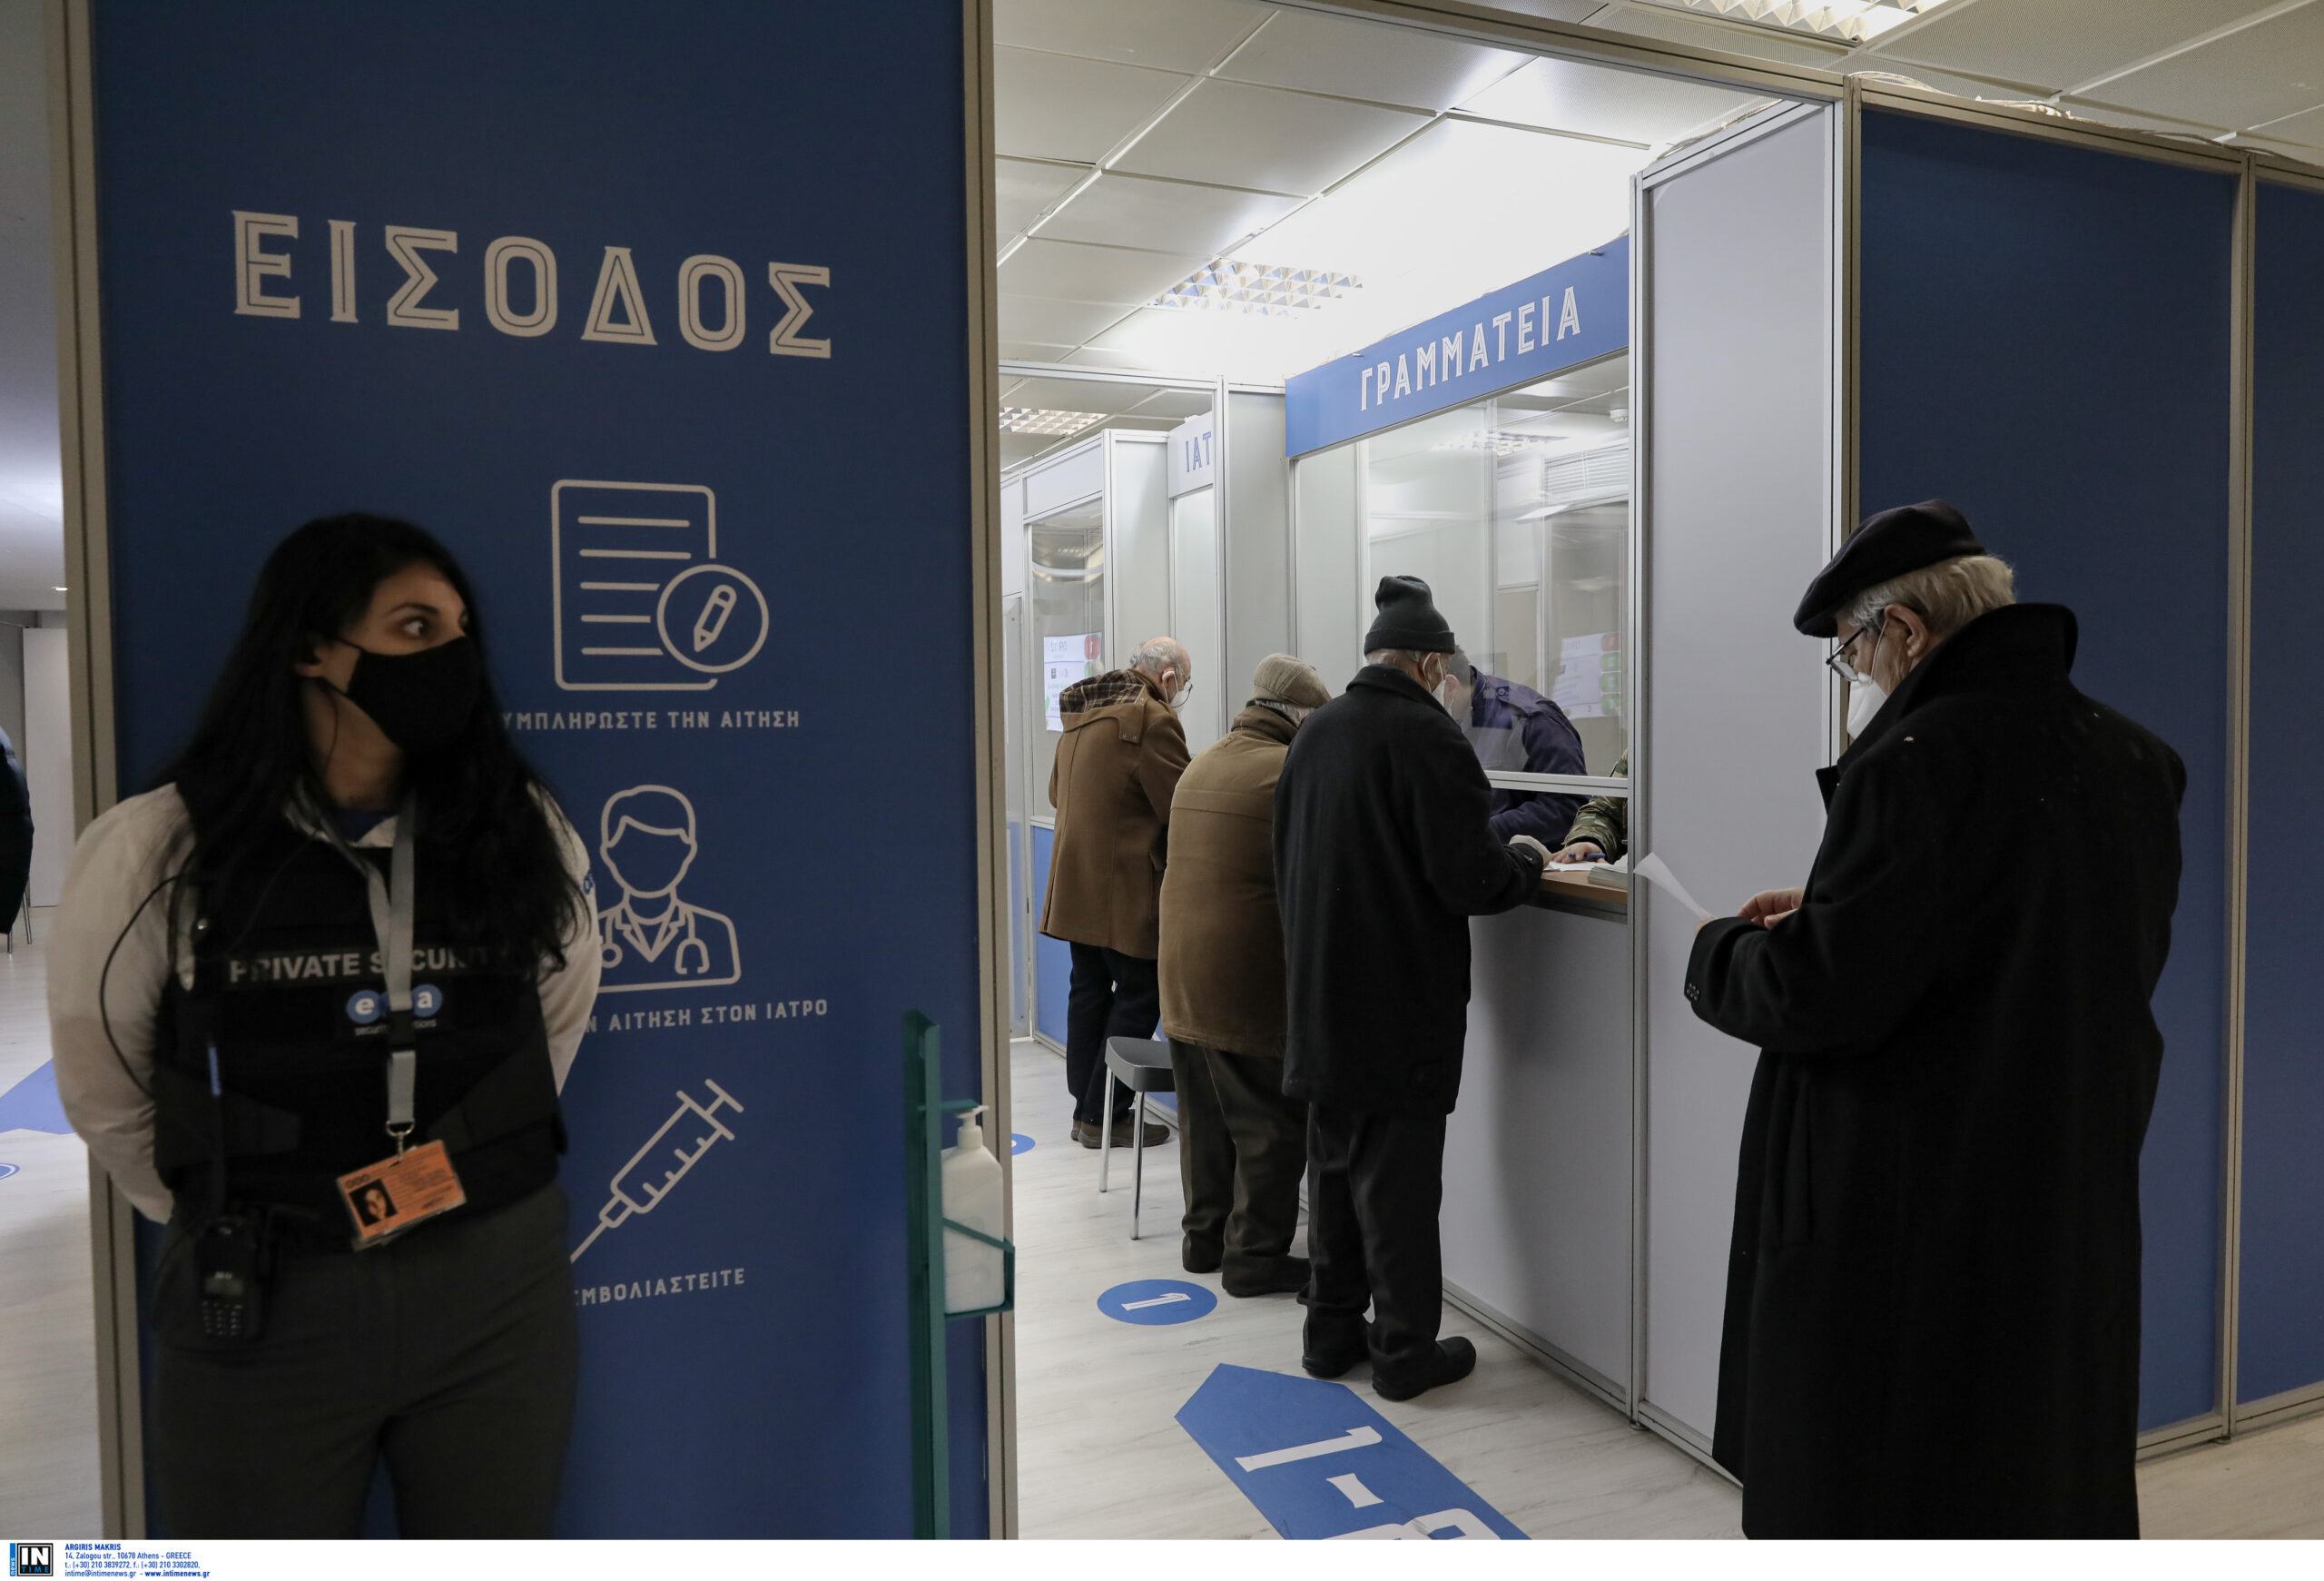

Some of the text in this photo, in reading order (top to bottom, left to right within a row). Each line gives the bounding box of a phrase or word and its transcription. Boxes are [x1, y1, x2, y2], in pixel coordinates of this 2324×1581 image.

[231, 210, 831, 358] ΕΙΣΟΔΟΣ
[1360, 286, 1581, 411] ΓΡΑΜΜΑΤΕΙΑ
[502, 711, 800, 729] ΥΜΠΛΗΡΩΣΤΕ ΤΗΝ ΑΙΤΗΣΗ
[230, 953, 361, 983] PRIVATE
[608, 1008, 691, 1032] ΑΙΤΗΣΗ
[701, 1003, 756, 1024] ΣΤΟΝ
[766, 999, 828, 1019] ΙΑΤΡΟ
[575, 1268, 745, 1307] ΜΒΟΛΙΑΣΤΕΙΤΕ
[1120, 1291, 1192, 1312] 1
